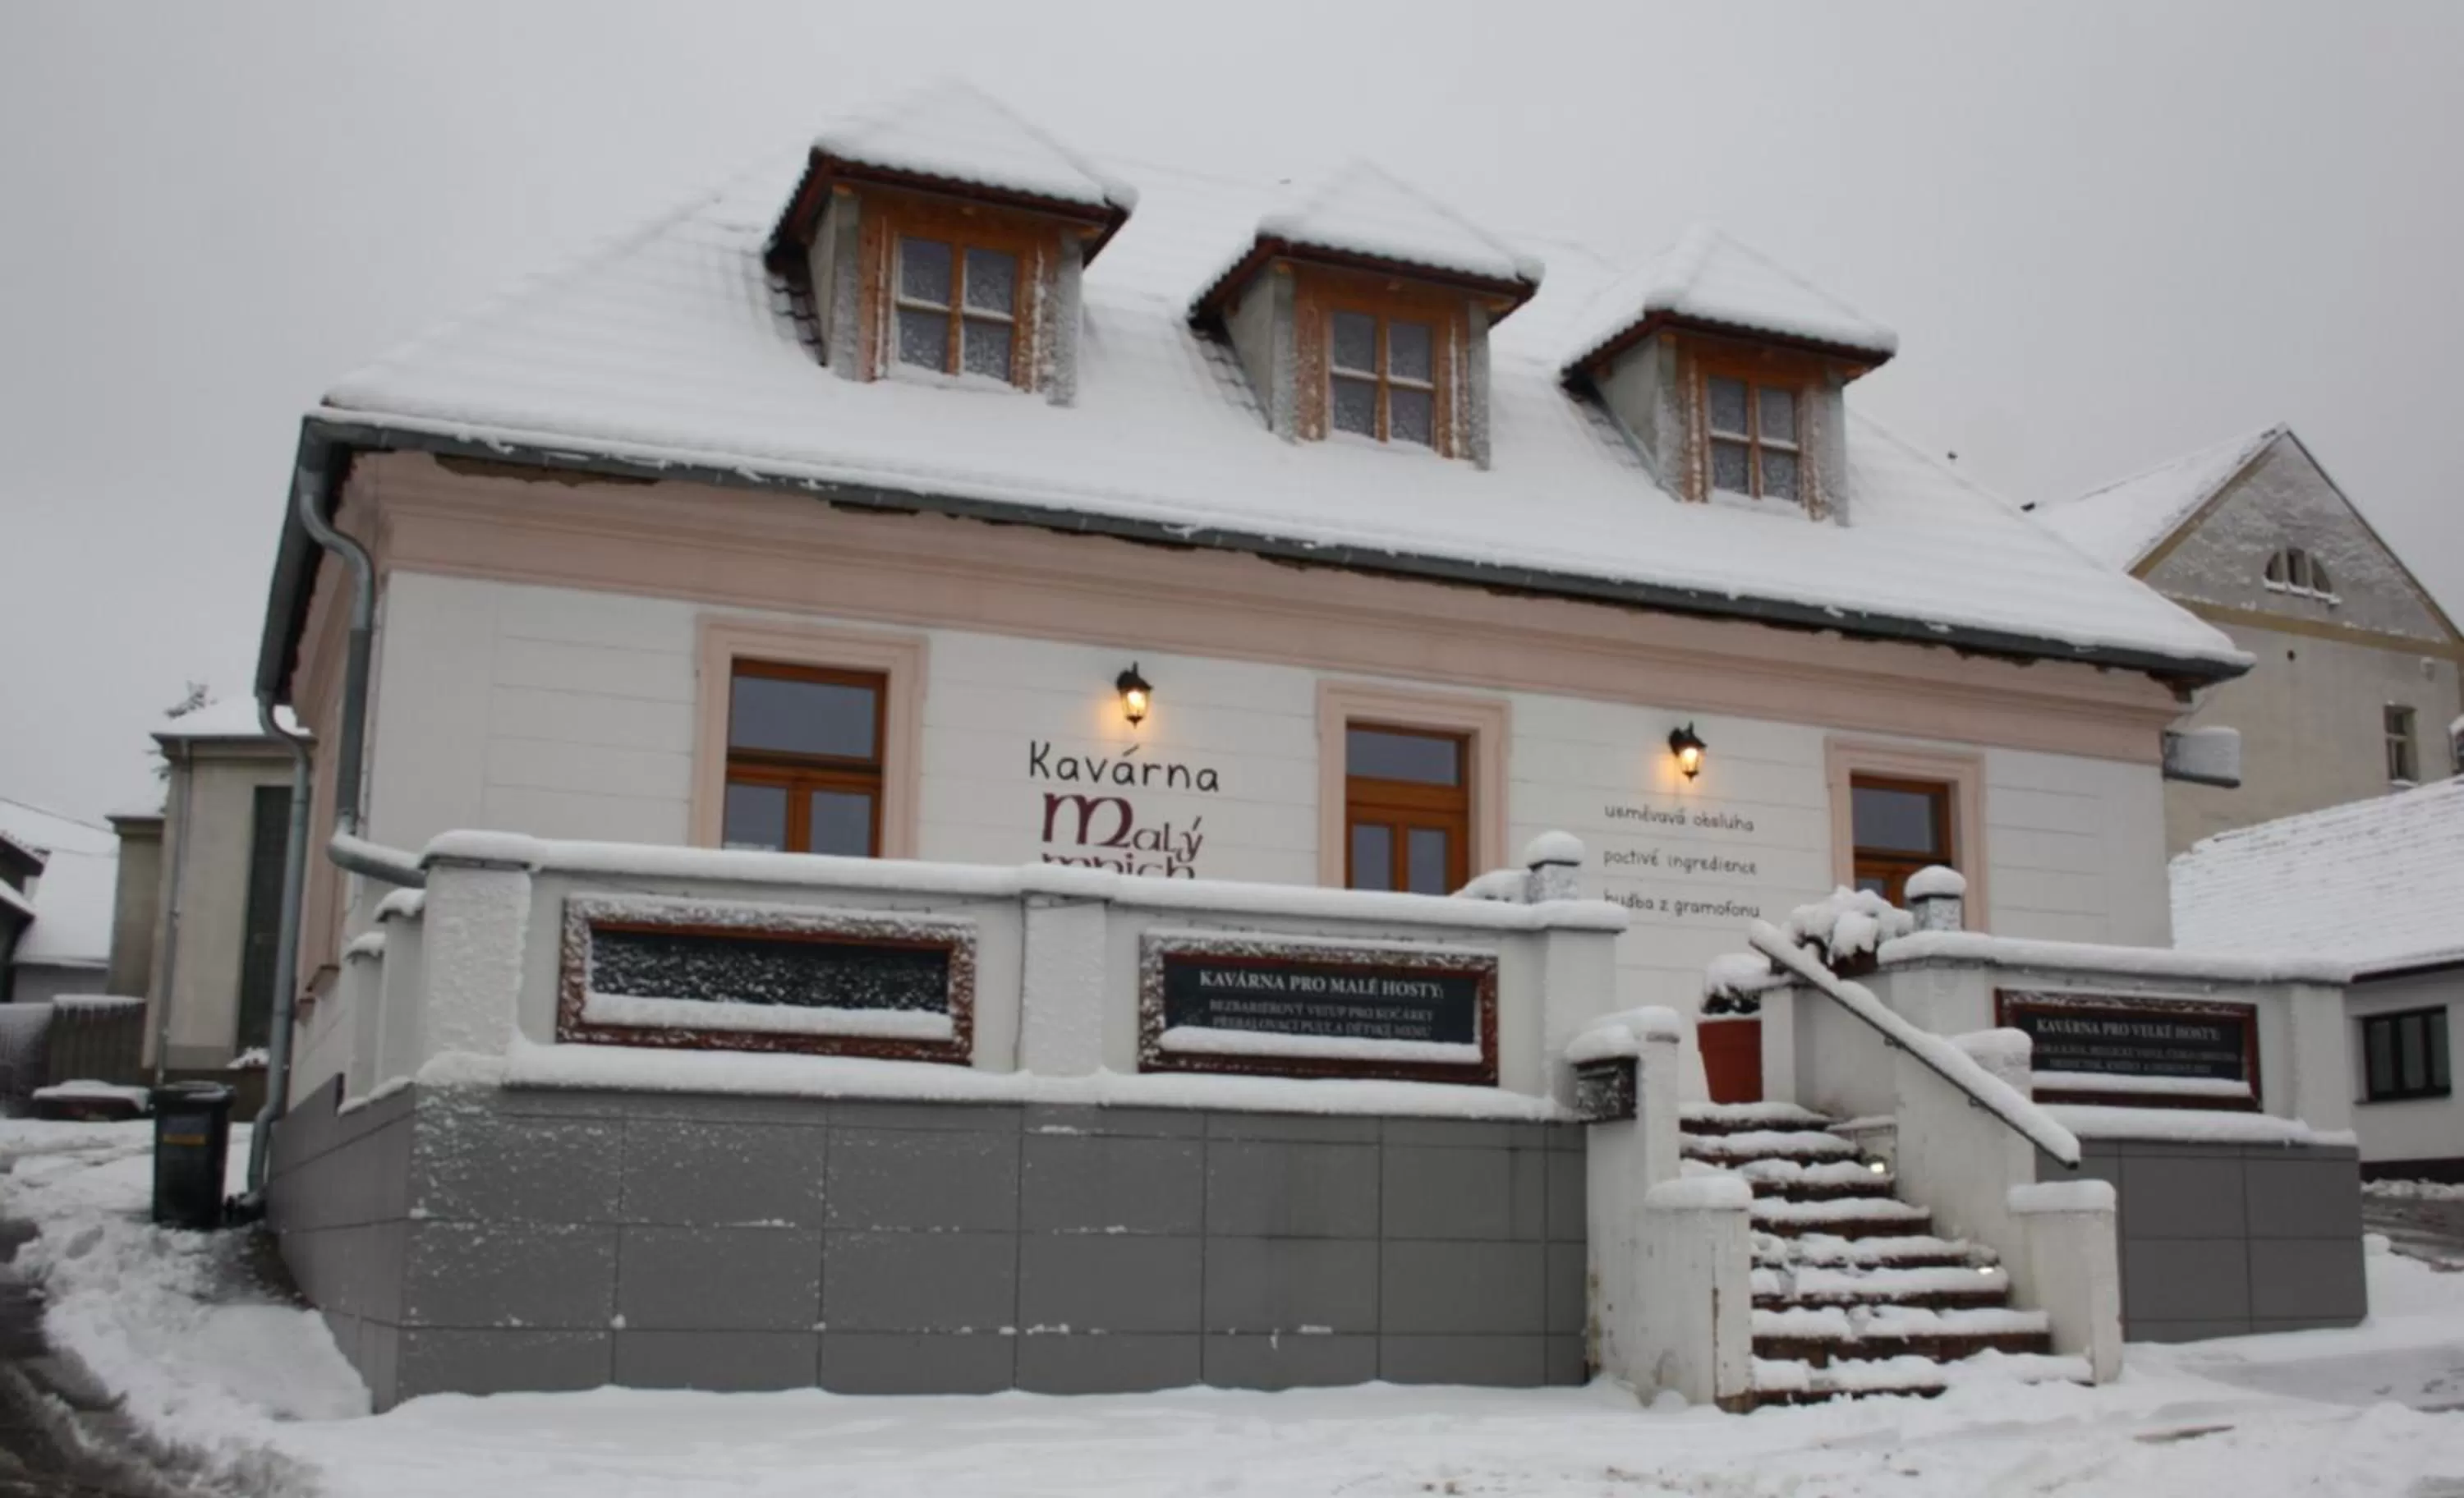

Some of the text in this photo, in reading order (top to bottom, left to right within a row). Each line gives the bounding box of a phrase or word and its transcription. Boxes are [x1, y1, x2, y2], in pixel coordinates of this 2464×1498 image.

[1029, 740, 1219, 792] Kavárna
[1041, 793, 1204, 863] Malý
[1693, 811, 1755, 833] obsluha
[1603, 847, 1758, 875] poctivé ingredience
[1659, 899, 1669, 912] z
[1674, 899, 1761, 919] gramofonu
[1199, 969, 1285, 990] KAVÁRNA
[1289, 975, 1326, 992] PRO
[1330, 976, 1379, 996] MALÉ
[2036, 1018, 2099, 1036] KAVÁRNA
[2102, 1021, 2130, 1036] PRO
